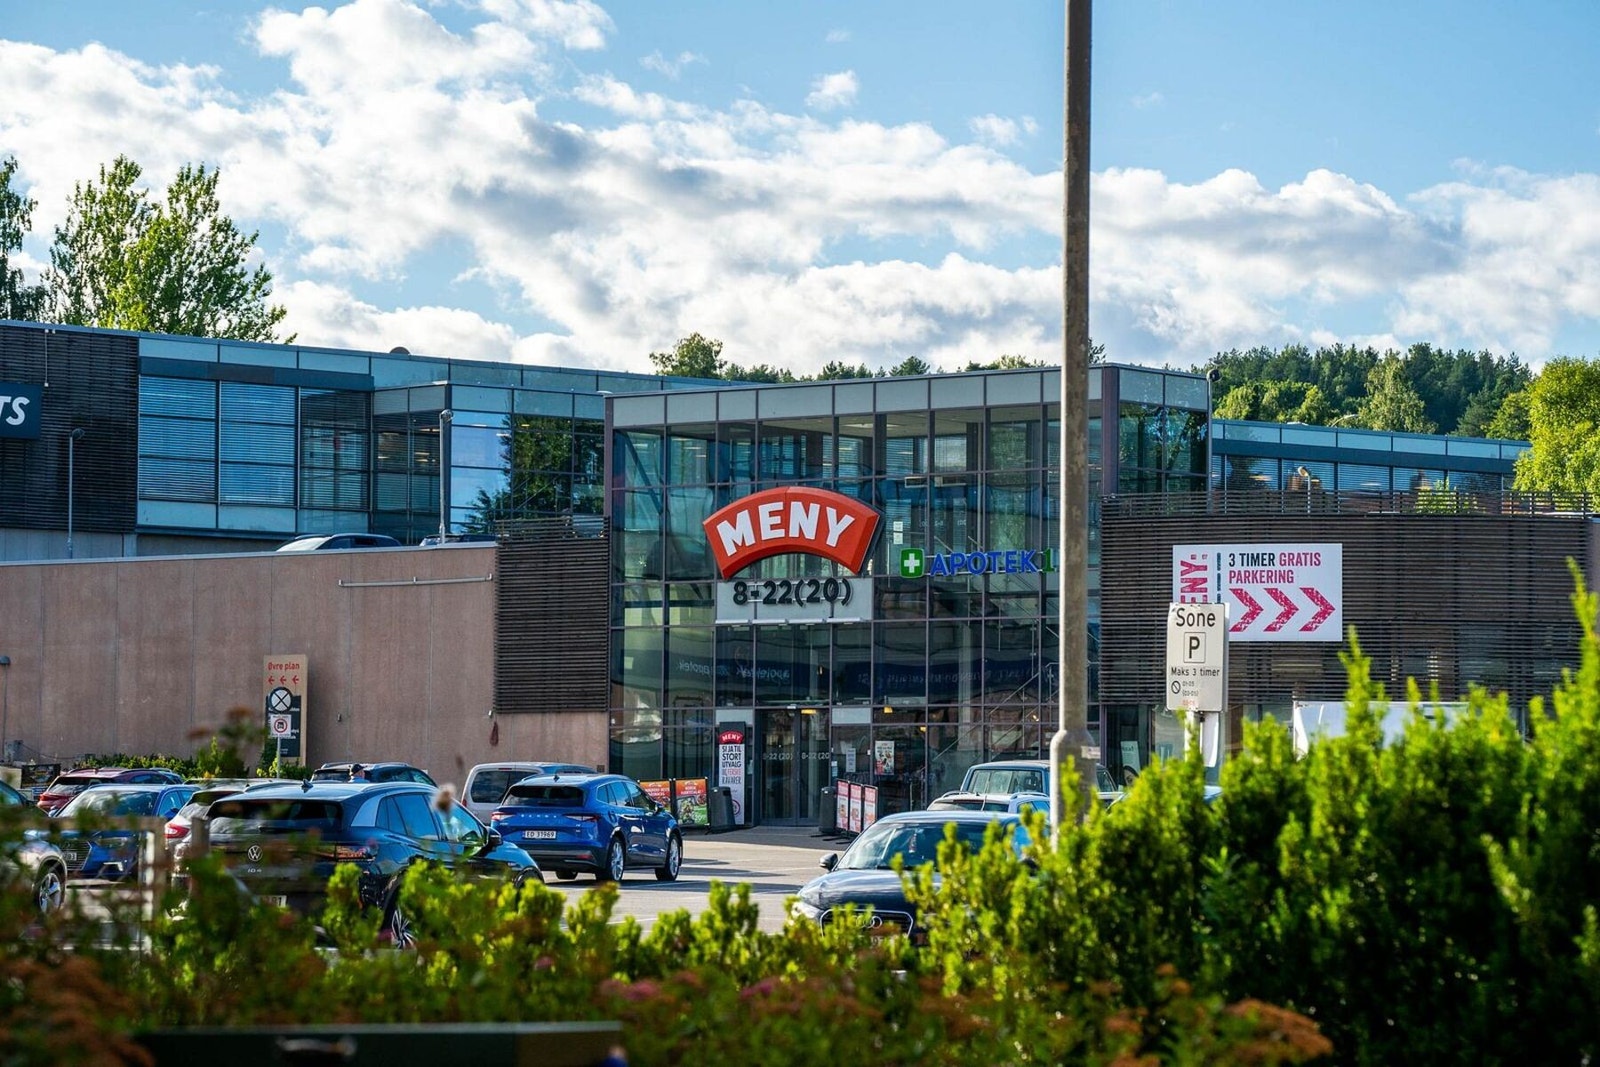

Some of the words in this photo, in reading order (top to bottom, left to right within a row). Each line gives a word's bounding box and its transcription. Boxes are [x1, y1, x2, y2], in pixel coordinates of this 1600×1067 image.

[716, 501, 855, 557] MENY
[930, 550, 1039, 577] APOTEK
[1042, 548, 1055, 573] 1
[1228, 552, 1236, 567] 3
[1239, 552, 1276, 567] TIMER
[1279, 552, 1321, 567] GRATIS
[1228, 569, 1295, 584] PARKERING
[1175, 607, 1216, 627] Sone
[1188, 636, 1201, 659] P
[285, 661, 300, 672] plan
[1171, 667, 1189, 677] Maks
[1192, 667, 1197, 677] 3
[1200, 667, 1220, 677] timer
[721, 733, 741, 741] MENY
[722, 753, 742, 761] STORT
